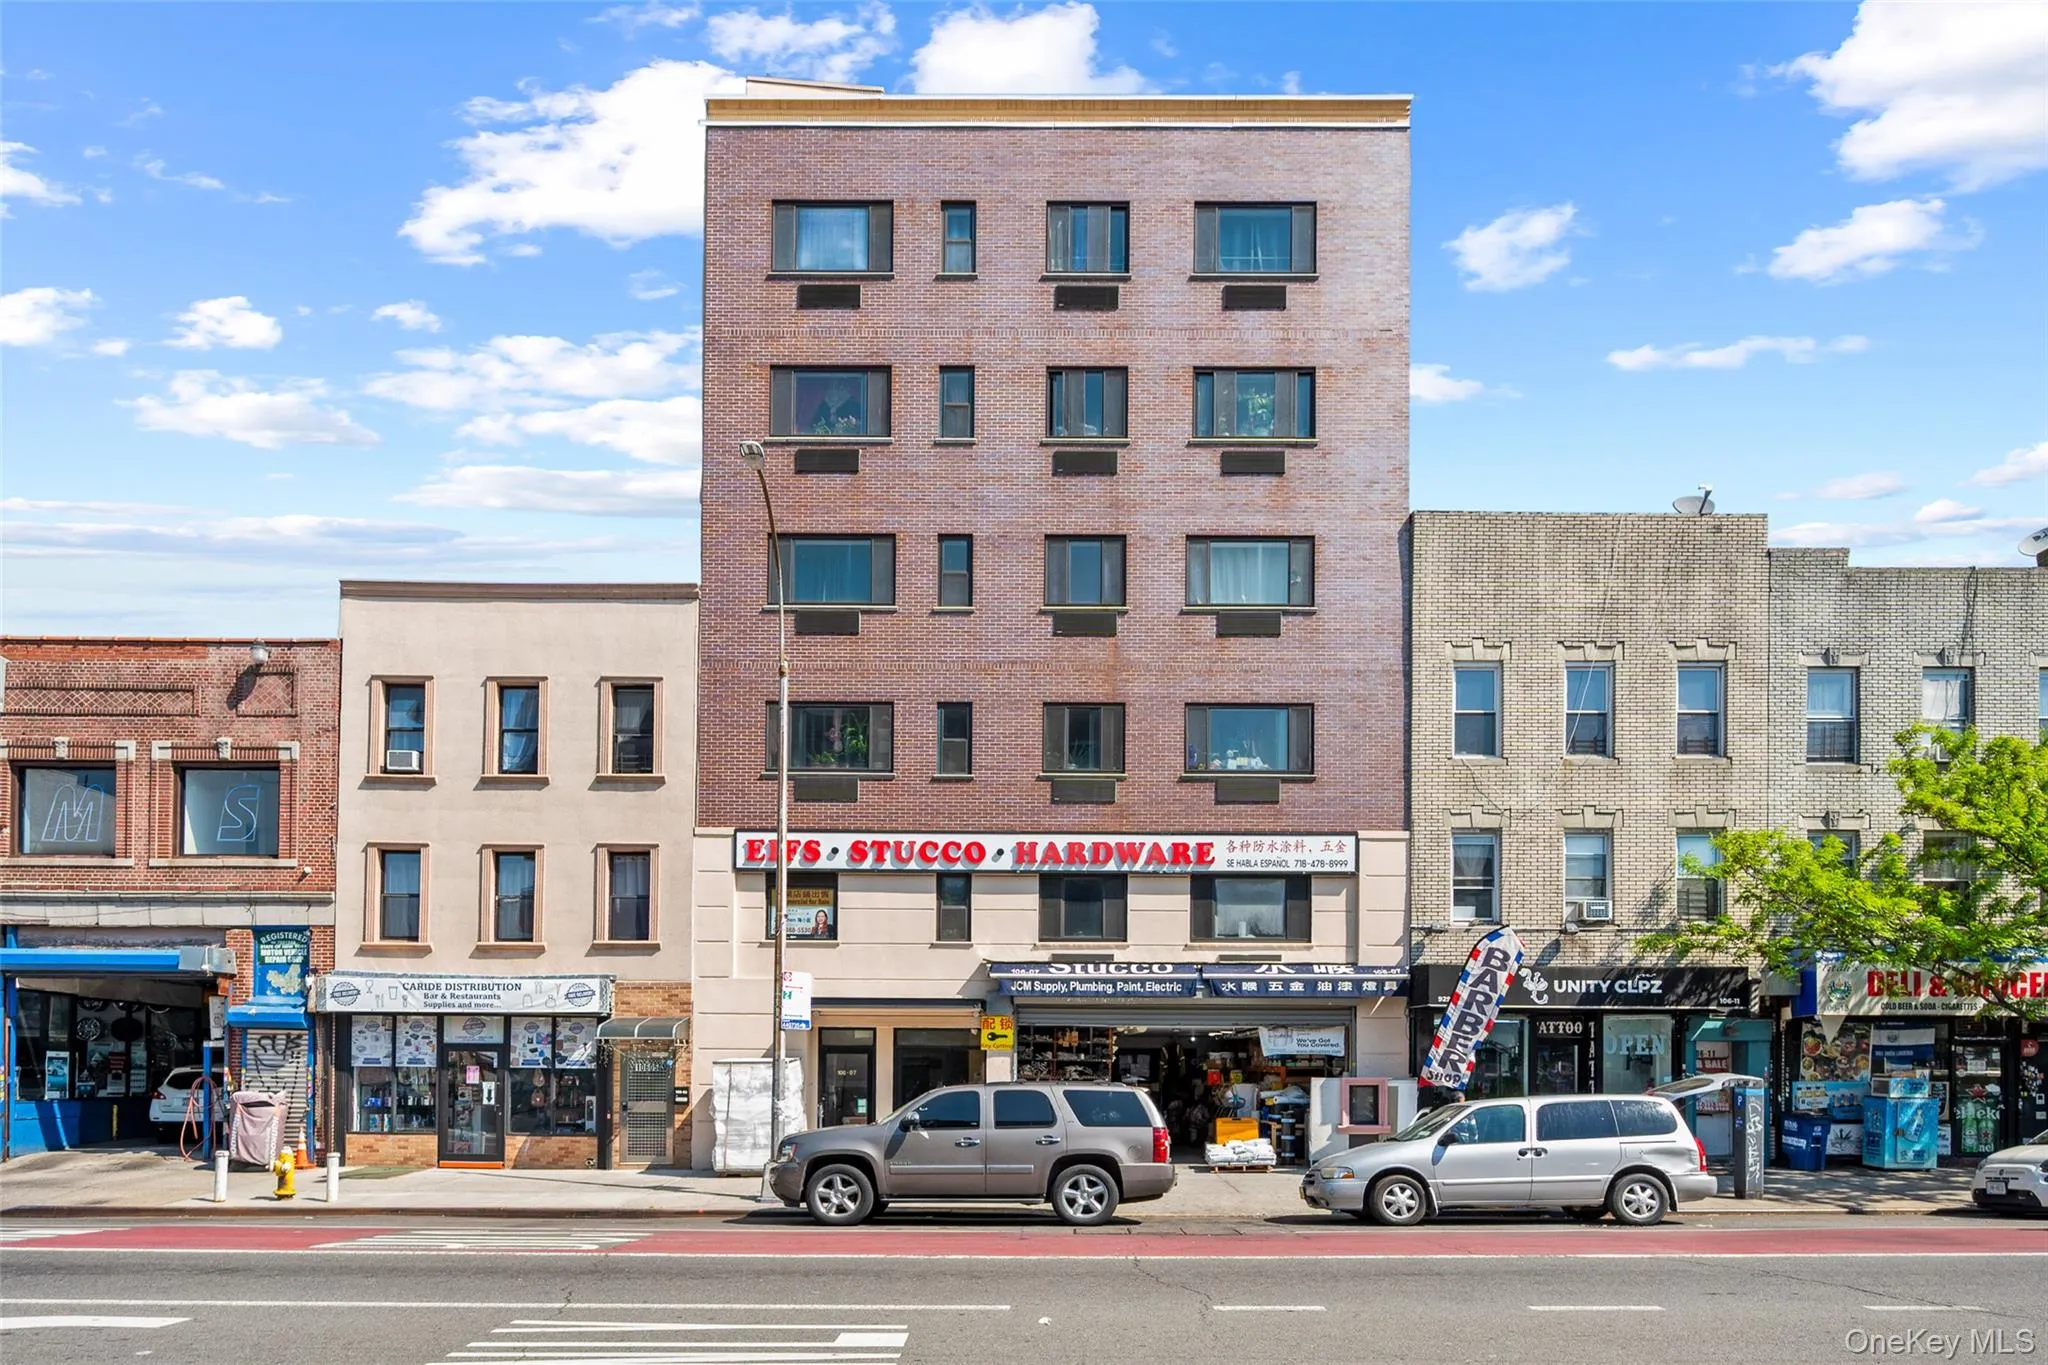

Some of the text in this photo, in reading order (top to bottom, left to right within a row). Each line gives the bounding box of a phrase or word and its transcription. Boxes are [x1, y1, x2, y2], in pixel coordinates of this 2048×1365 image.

[849, 840, 987, 864] STUCCO
[1015, 841, 1215, 865] HARDWARE
[1226, 859, 1235, 868] SE
[1236, 859, 1259, 868] HABLA
[1294, 859, 1349, 868] 718-478-8999
[260, 932, 308, 943] REGISTERED
[402, 982, 522, 991] CARIDE DISTRIBUTION
[1010, 981, 1182, 994] JCM Supply, Plumbing, Paint, Electric
[1553, 979, 1612, 993] UNITY
[423, 992, 501, 1000] Bar & Restaurants
[1719, 997, 1740, 1005] 106-11
[423, 1001, 456, 1009] Supplies
[1437, 946, 1511, 1073] BARBER
[1880, 1002, 1897, 1011] COLD
[1897, 1002, 1913, 1011] BEER
[1919, 1002, 1937, 1011] SODA
[1941, 1002, 1978, 1011] CIGARETTES
[1536, 1021, 1583, 1035] ATTOO
[1604, 1033, 1668, 1057] OPEN
[1704, 1059, 1728, 1069] SALE
